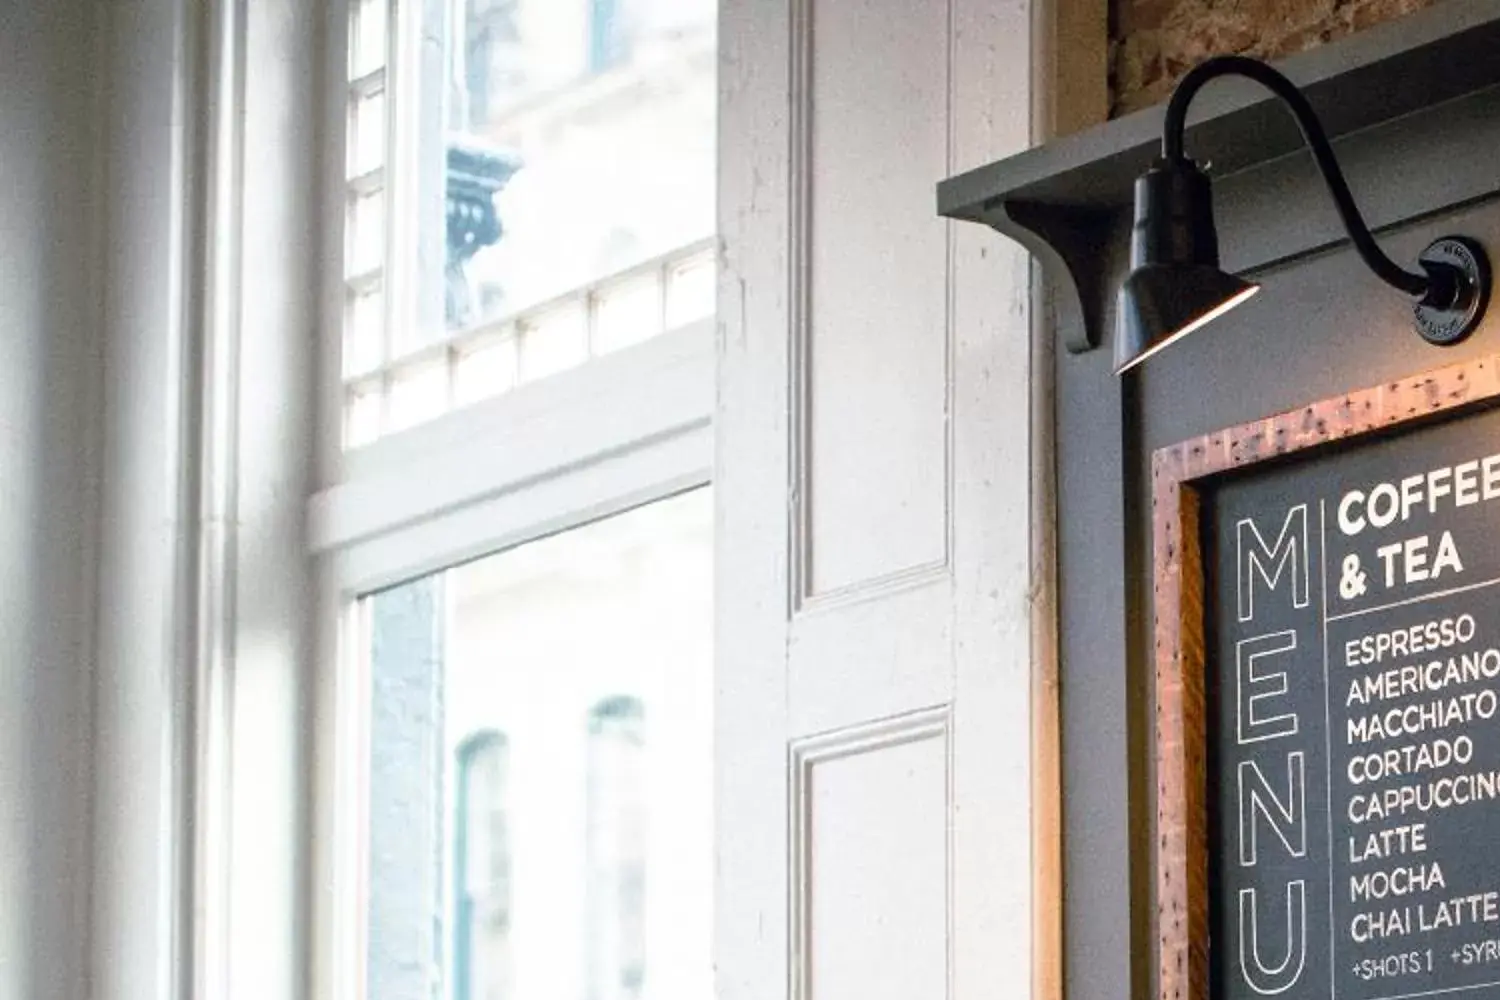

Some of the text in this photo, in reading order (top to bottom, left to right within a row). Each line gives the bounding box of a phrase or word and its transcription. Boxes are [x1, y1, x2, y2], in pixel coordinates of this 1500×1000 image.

[1338, 529, 1464, 600] & TEA
[1346, 613, 1476, 668] ESPRESSO
[1347, 689, 1497, 745] MACCHIATO
[1348, 735, 1473, 785] CORTADO
[1349, 823, 1428, 863] LATTE
[1350, 862, 1445, 903] MOCHA
[1350, 906, 1412, 943] CHAI
[1418, 891, 1499, 932] LATTE
[1352, 949, 1433, 981] +SHOTS 1
